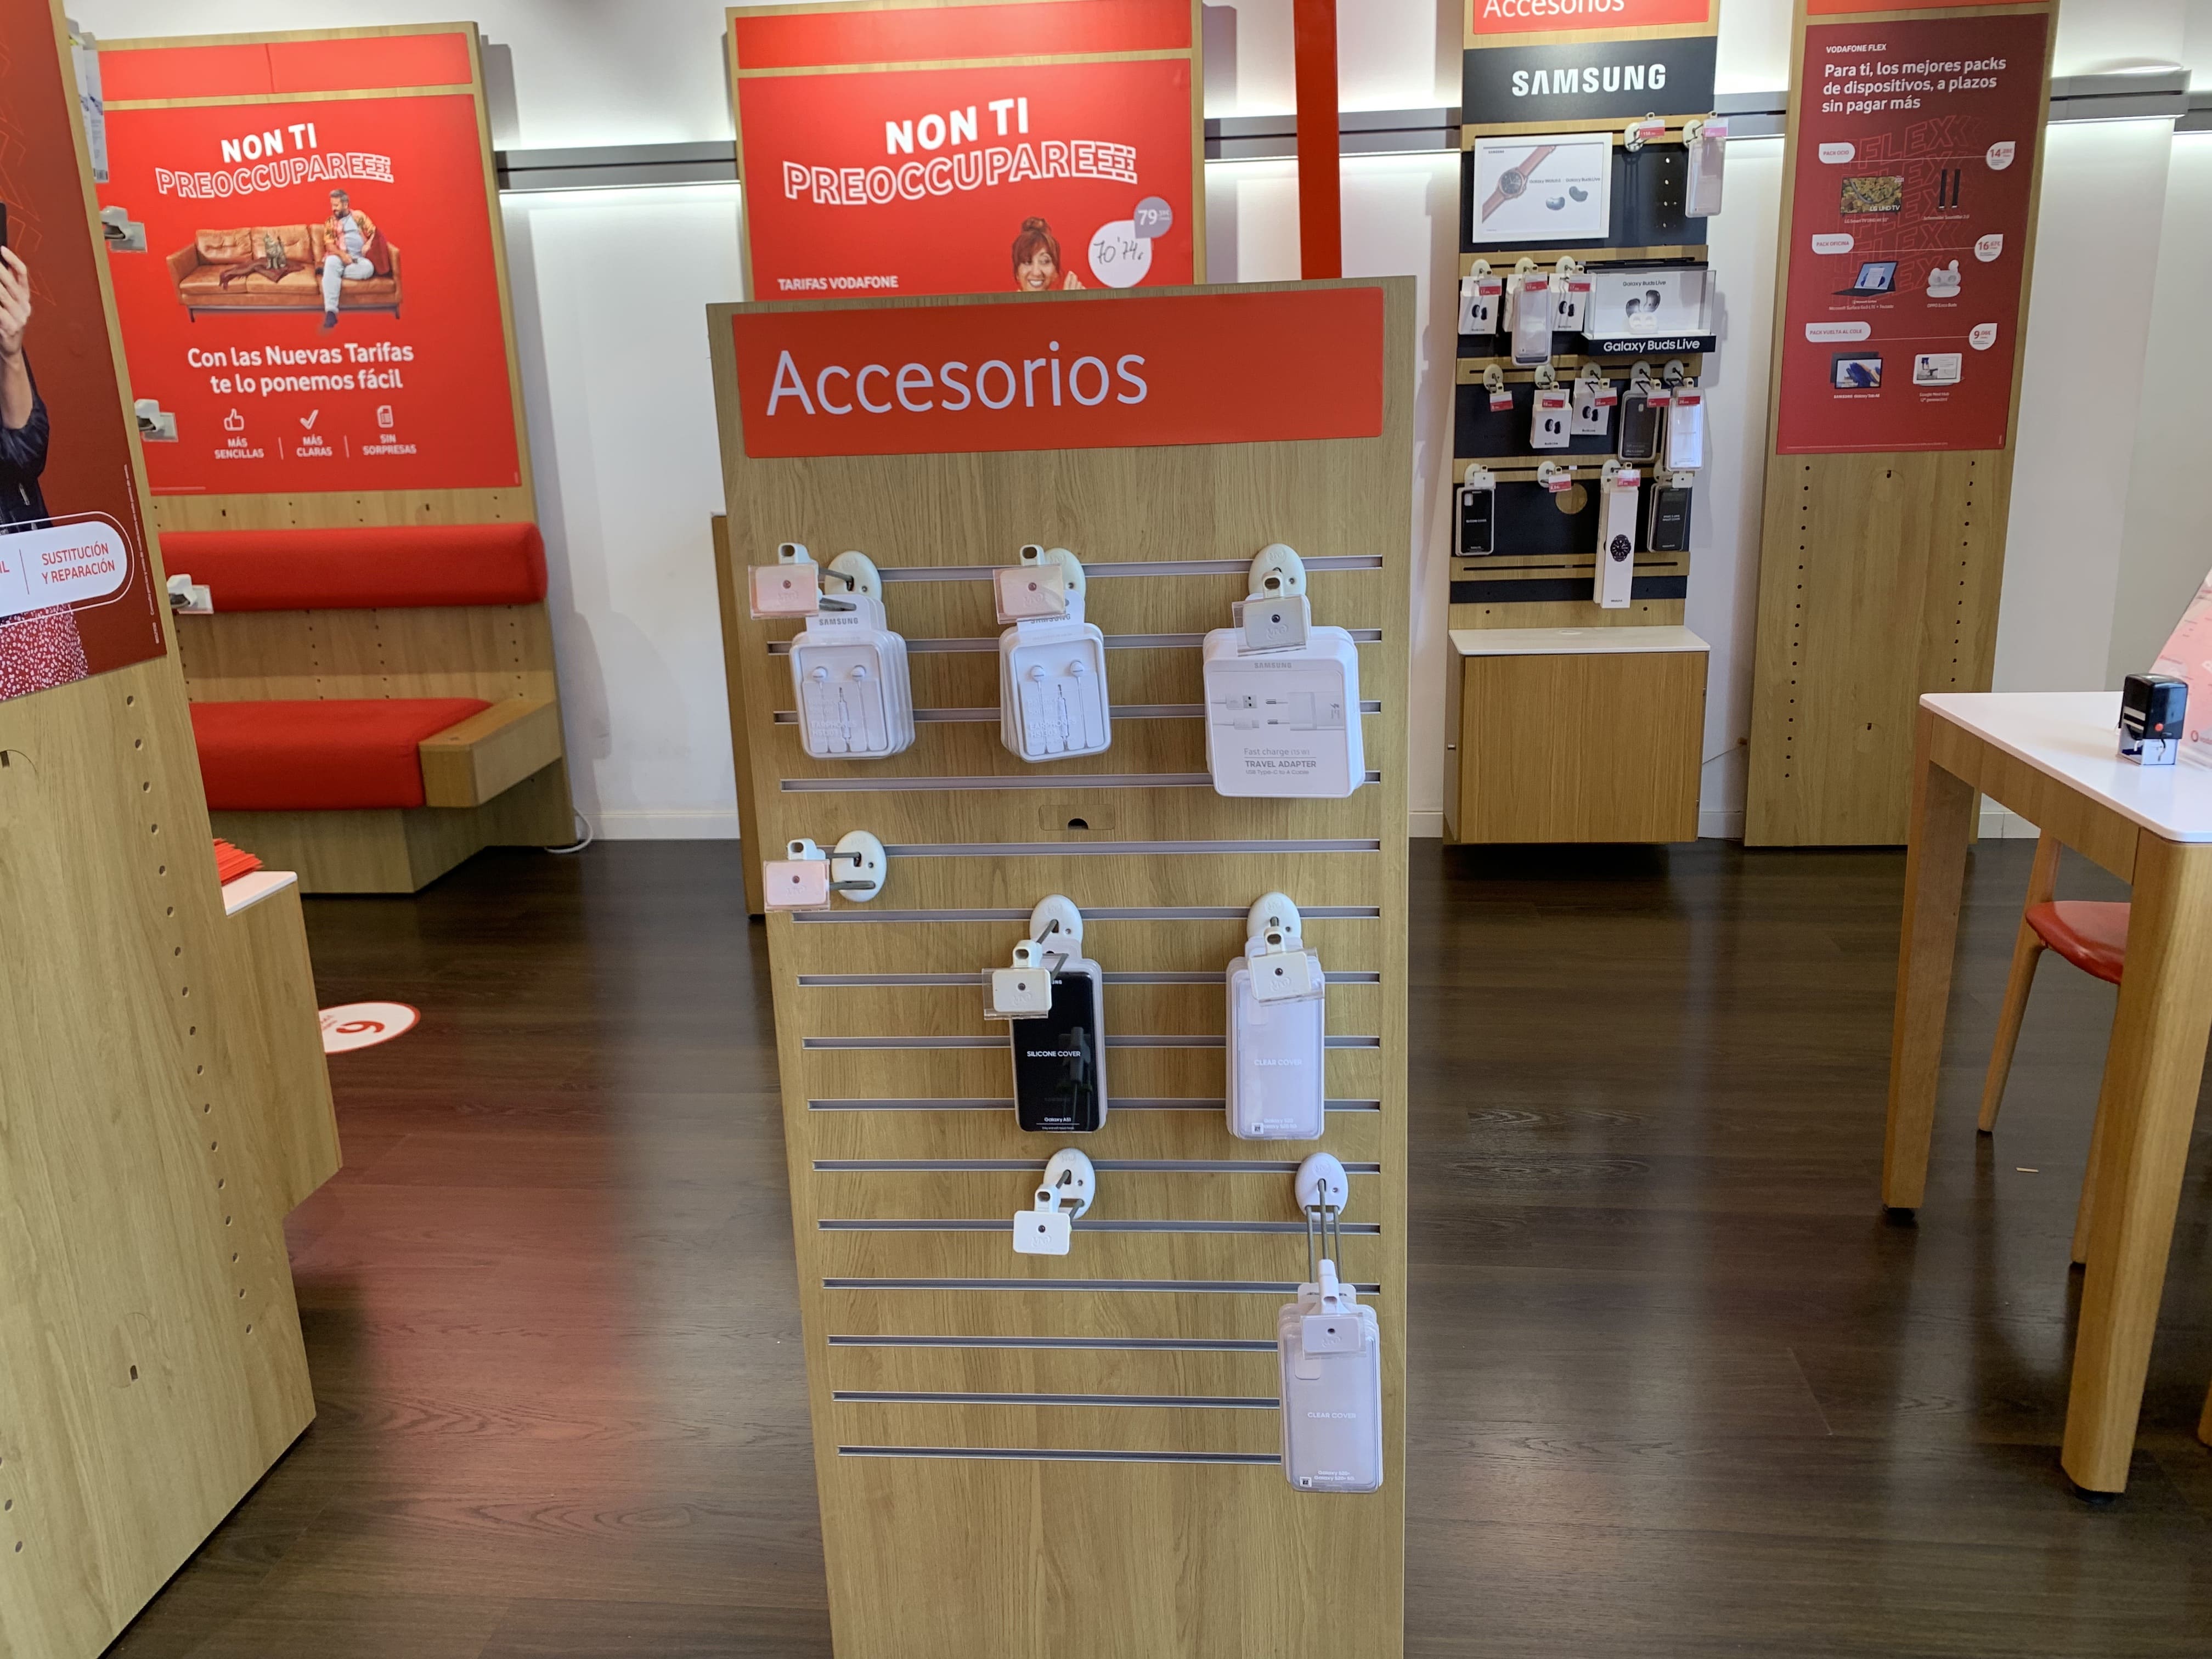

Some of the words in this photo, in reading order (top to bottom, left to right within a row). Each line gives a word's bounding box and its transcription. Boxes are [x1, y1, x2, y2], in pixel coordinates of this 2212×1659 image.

[1826, 45, 1867, 53] VODAFONE
[1825, 64, 1857, 77] Para
[1860, 63, 1874, 77] ti,
[1877, 62, 1899, 75] los
[1902, 60, 1961, 76] mejores
[1963, 57, 2006, 74] packs
[1512, 64, 1666, 97] SAMSUNG
[1823, 82, 1841, 95] de
[1844, 78, 1934, 96] dispositivos,
[1937, 79, 1946, 89] a
[1949, 76, 1997, 93] plazos
[1821, 99, 1843, 113] sin
[1847, 99, 1887, 115] pagar
[1890, 95, 1921, 109] más
[885, 106, 979, 156] NON
[989, 97, 1029, 136] TI
[221, 129, 284, 163] NON
[288, 123, 317, 150] TI
[777, 278, 828, 291] TARIFAS
[829, 275, 899, 290] VODAFONE
[188, 348, 227, 368] Con
[231, 347, 262, 366] las
[265, 345, 342, 365] Nuevas
[344, 342, 414, 363] Tarifas
[1604, 341, 1646, 353] Galaxy
[1647, 340, 1676, 350] Buds
[1677, 338, 1700, 349] Live
[210, 376, 232, 393] te
[235, 374, 256, 393] lo
[260, 374, 354, 397] ponemos
[357, 369, 403, 389] fácil
[767, 341, 1148, 416] Accesorios
[228, 436, 247, 448] MÁS
[303, 435, 323, 445] MÁS
[380, 434, 397, 444] SIN
[215, 448, 264, 459] SENCILLAS
[296, 446, 332, 457] CLARAS
[362, 444, 417, 455] SORPRESAS
[42, 541, 109, 565] SUSTITUCIÓN
[41, 572, 48, 584] Y
[51, 558, 115, 583] REPARACIÓN
[1262, 747, 1289, 757] charge
